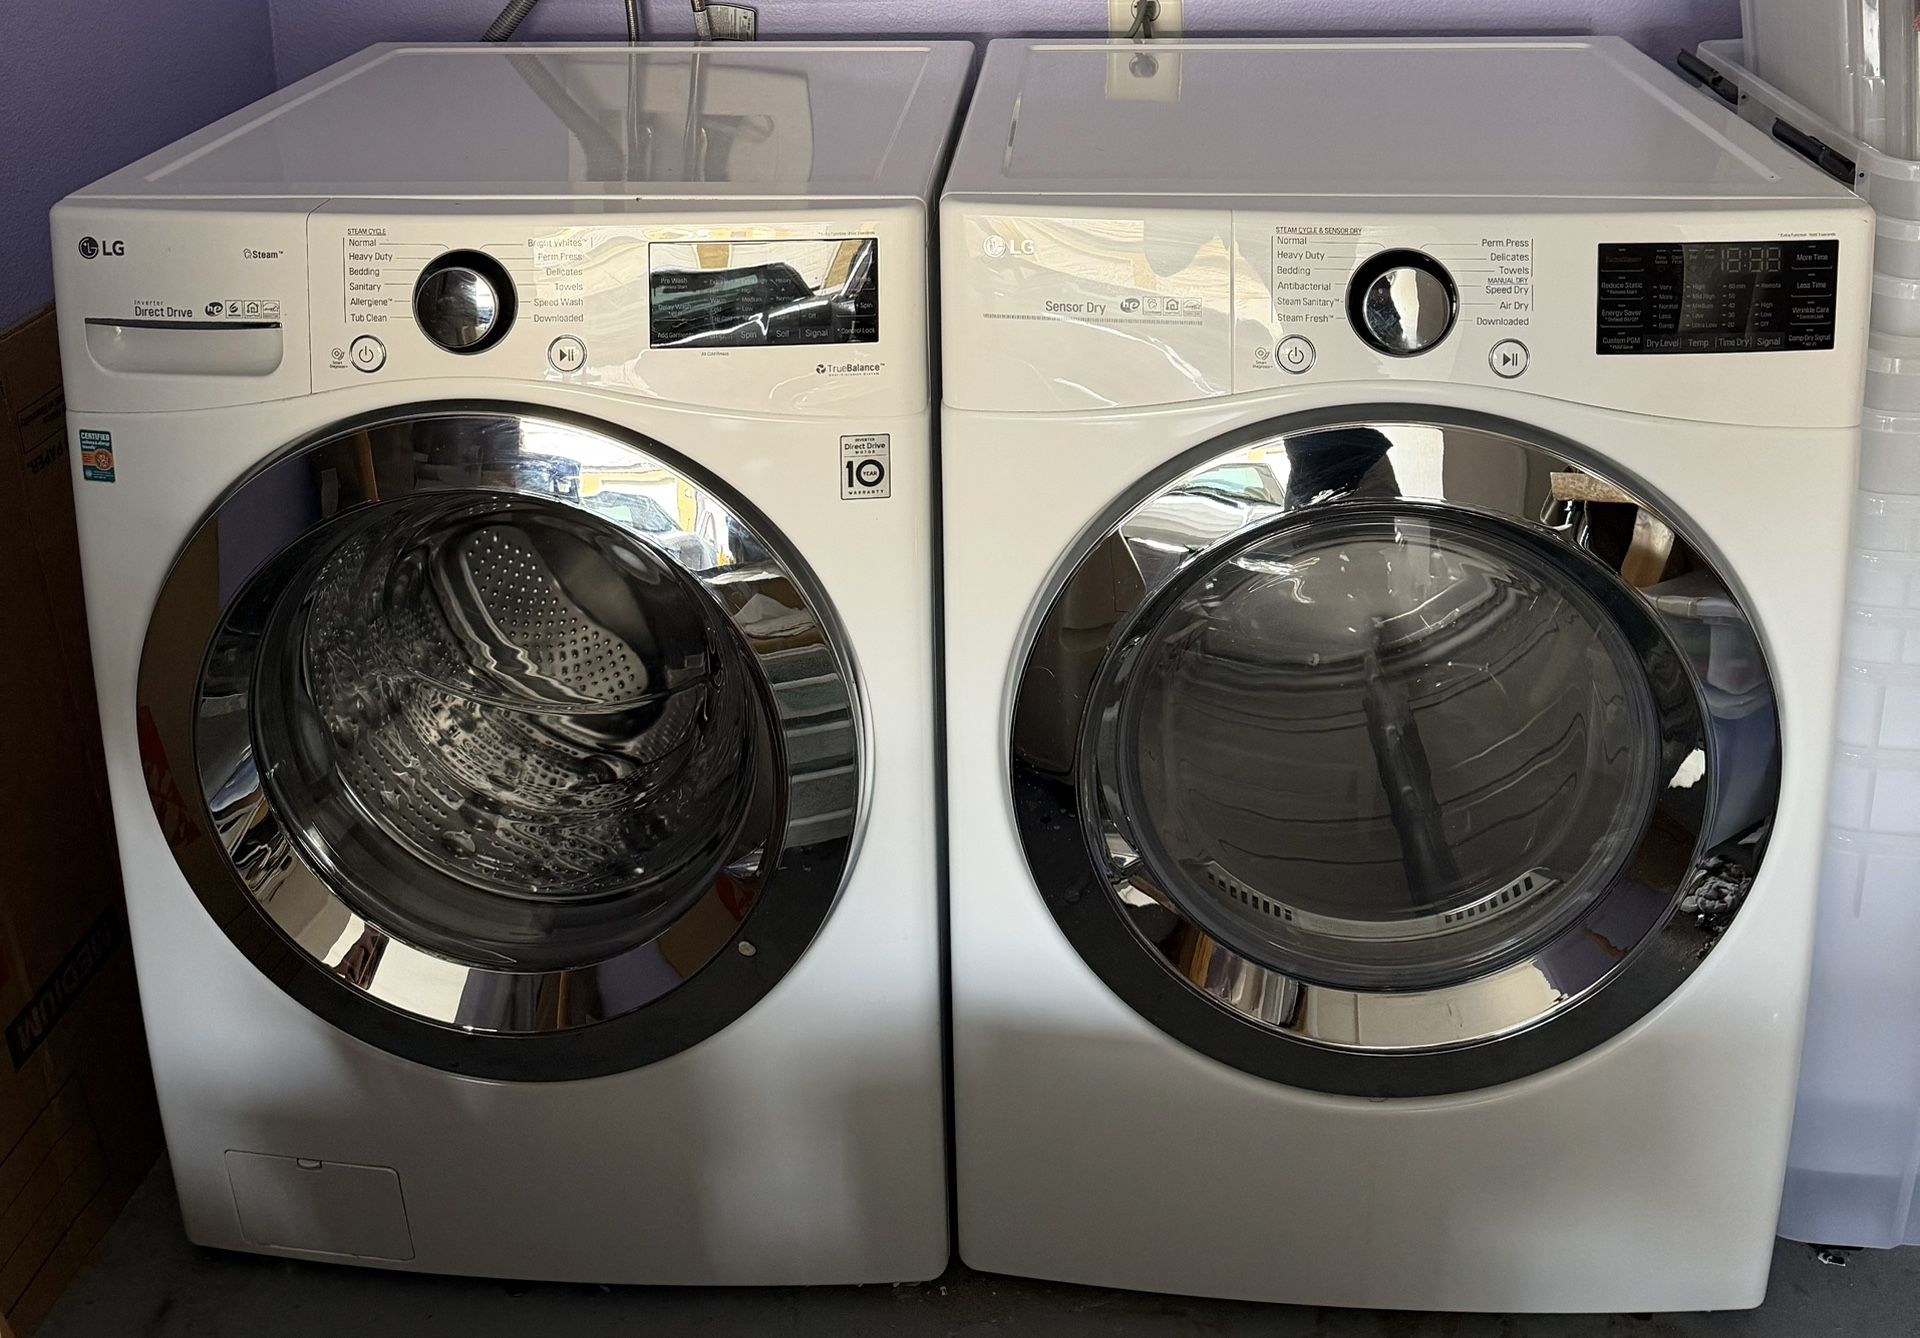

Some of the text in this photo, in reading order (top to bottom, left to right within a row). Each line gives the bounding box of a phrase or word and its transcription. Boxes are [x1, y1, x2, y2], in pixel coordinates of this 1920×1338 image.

[349, 238, 377, 247] Normal
[1277, 236, 1307, 245] Normal
[1506, 239, 1529, 247] Press
[102, 240, 125, 256] LG
[1009, 240, 1035, 255] LG
[349, 252, 393, 262] Heavy Duty
[560, 252, 584, 261] Press
[1277, 251, 1325, 261] Heavy Duty
[1490, 253, 1529, 262] Delicates
[1814, 253, 1828, 261] Time
[349, 267, 380, 277] Bedding
[546, 267, 584, 276] Delicates
[1277, 266, 1311, 276] Bedding
[1499, 266, 1529, 275] Towels
[349, 282, 382, 292] Sanitary
[555, 283, 584, 292] Towels
[1277, 281, 1331, 291] Antibacterial
[1797, 281, 1811, 289] Less
[1486, 286, 1529, 295] Speed Dry
[534, 298, 584, 308] Speed Wash
[1277, 297, 1301, 306] Steam
[1045, 300, 1107, 316] Sensor Dry
[1500, 301, 1529, 312] Air Dry
[135, 307, 193, 318] Direct Drive
[350, 313, 388, 323] Tub Clean
[533, 313, 584, 323] Downloaded
[1277, 313, 1304, 322] Steam
[1476, 317, 1529, 326] Downloaded
[805, 329, 829, 339] Signal
[861, 326, 876, 334] Lock
[741, 331, 758, 340] Spin
[1804, 334, 1815, 342] Dry
[1814, 334, 1831, 342] Signal
[1646, 339, 1680, 348] Dry Level
[1718, 338, 1750, 348] Time Dry
[1757, 337, 1781, 348] Signal
[81, 432, 110, 441] CERTIFIED
[846, 459, 885, 487] 10
[17, 922, 113, 1052] MEDIUM
